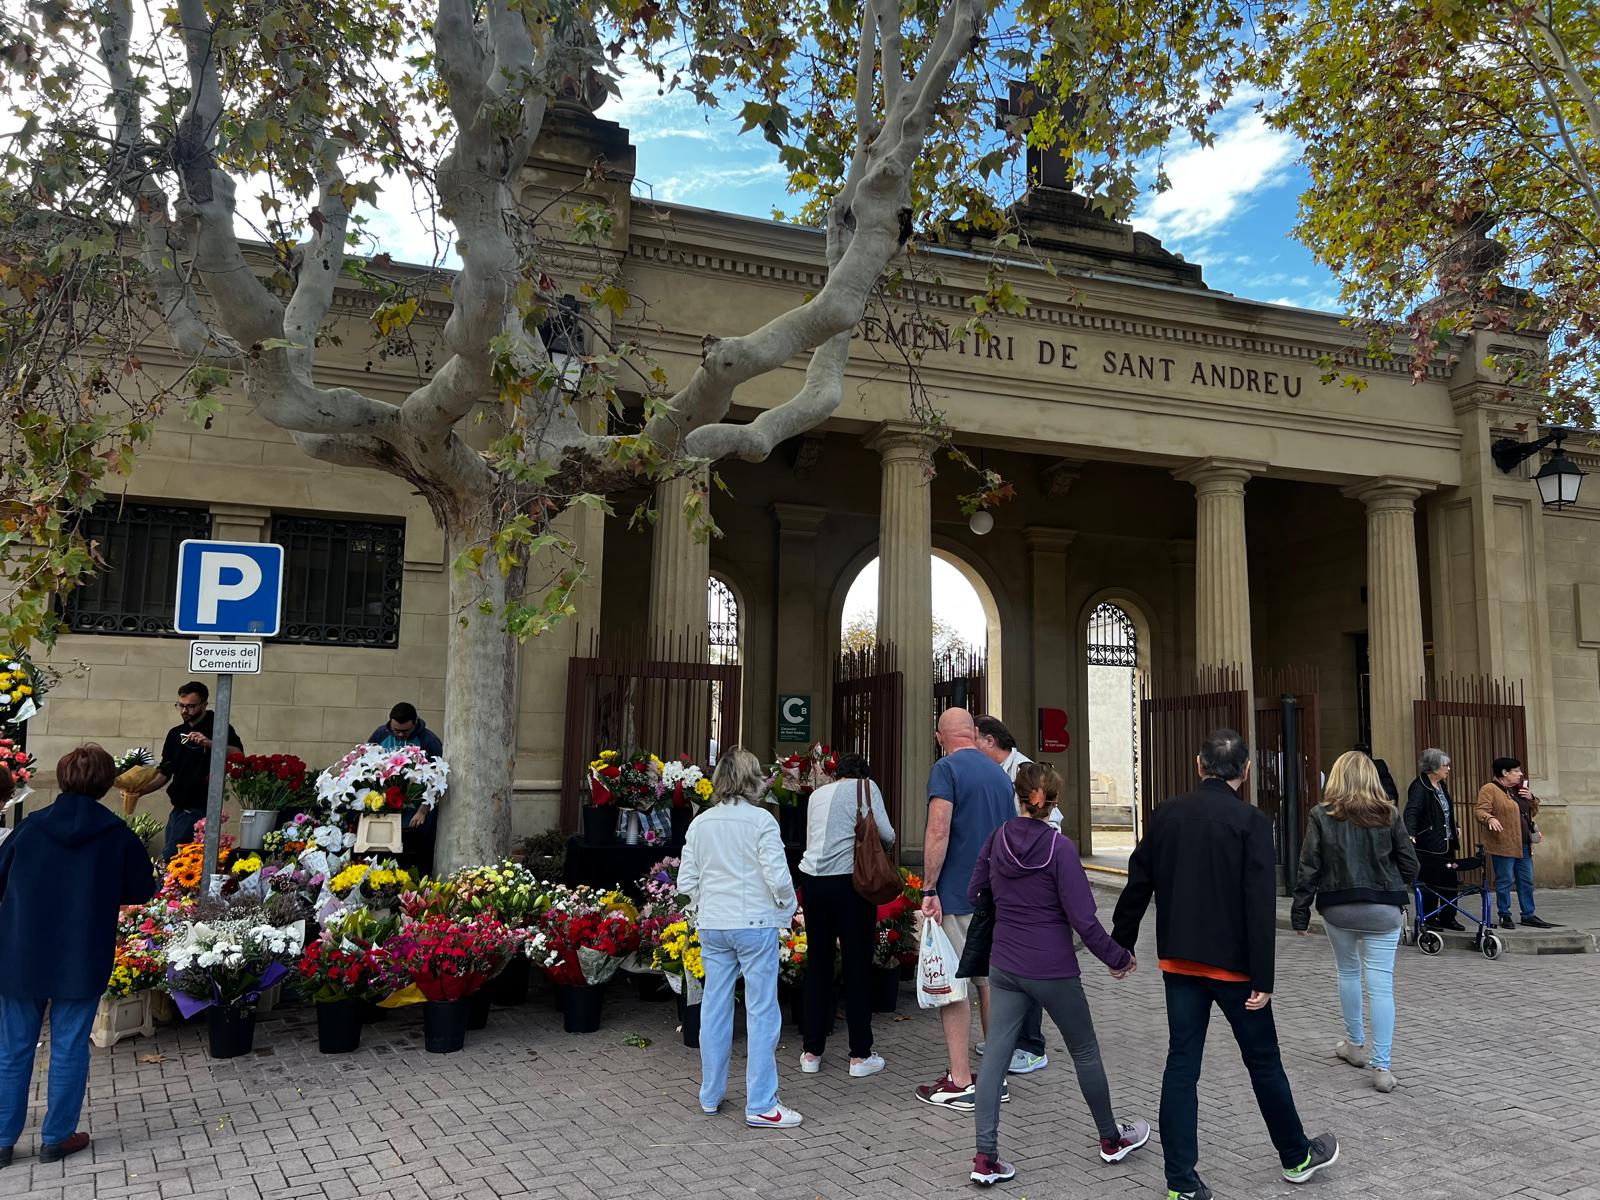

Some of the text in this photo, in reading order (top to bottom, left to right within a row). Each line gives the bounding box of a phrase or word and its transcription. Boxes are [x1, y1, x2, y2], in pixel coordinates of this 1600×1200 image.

[851, 316, 1303, 398] EMENTIRI DE SANT ANDREU
[196, 551, 262, 625] P
[195, 646, 257, 657] Serveis del
[199, 658, 252, 669] Cementiri
